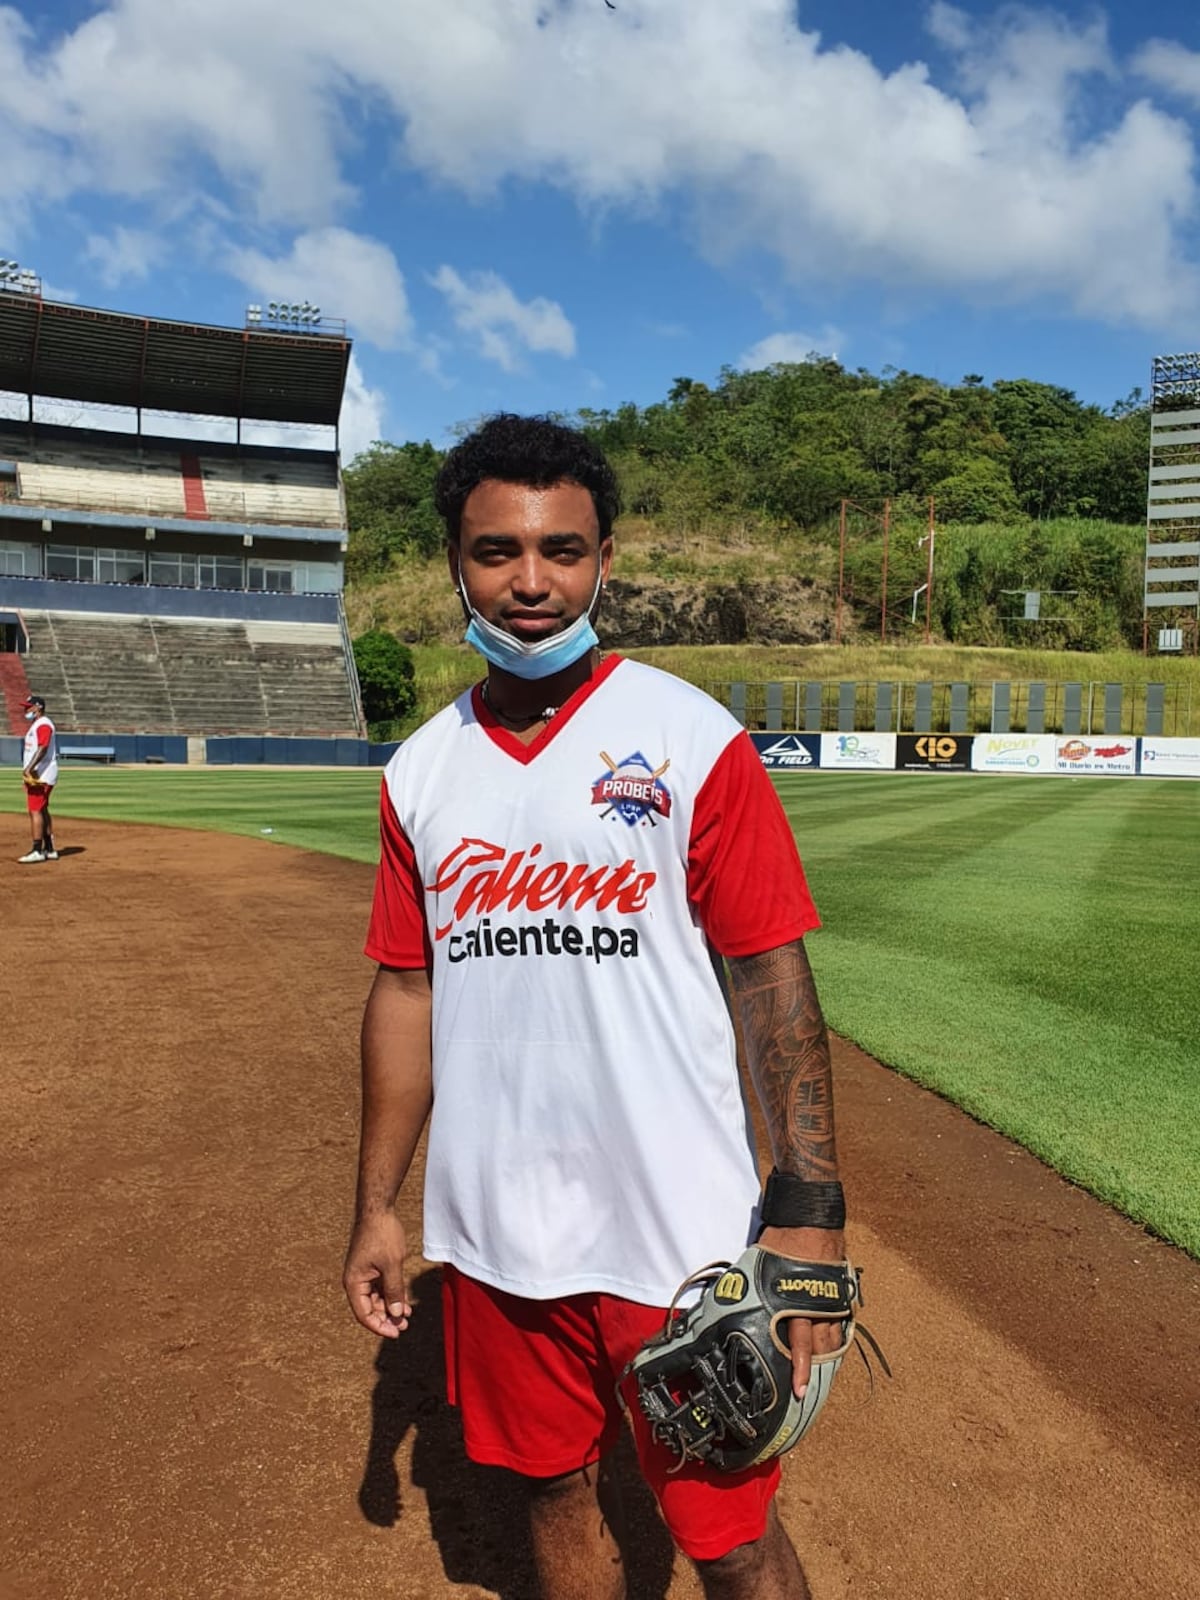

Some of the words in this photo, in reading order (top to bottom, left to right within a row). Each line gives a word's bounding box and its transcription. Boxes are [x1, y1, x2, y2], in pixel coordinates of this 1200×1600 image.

[914, 737, 957, 758] KIO
[777, 756, 813, 765] FIELD
[778, 1277, 841, 1299] Wilson
